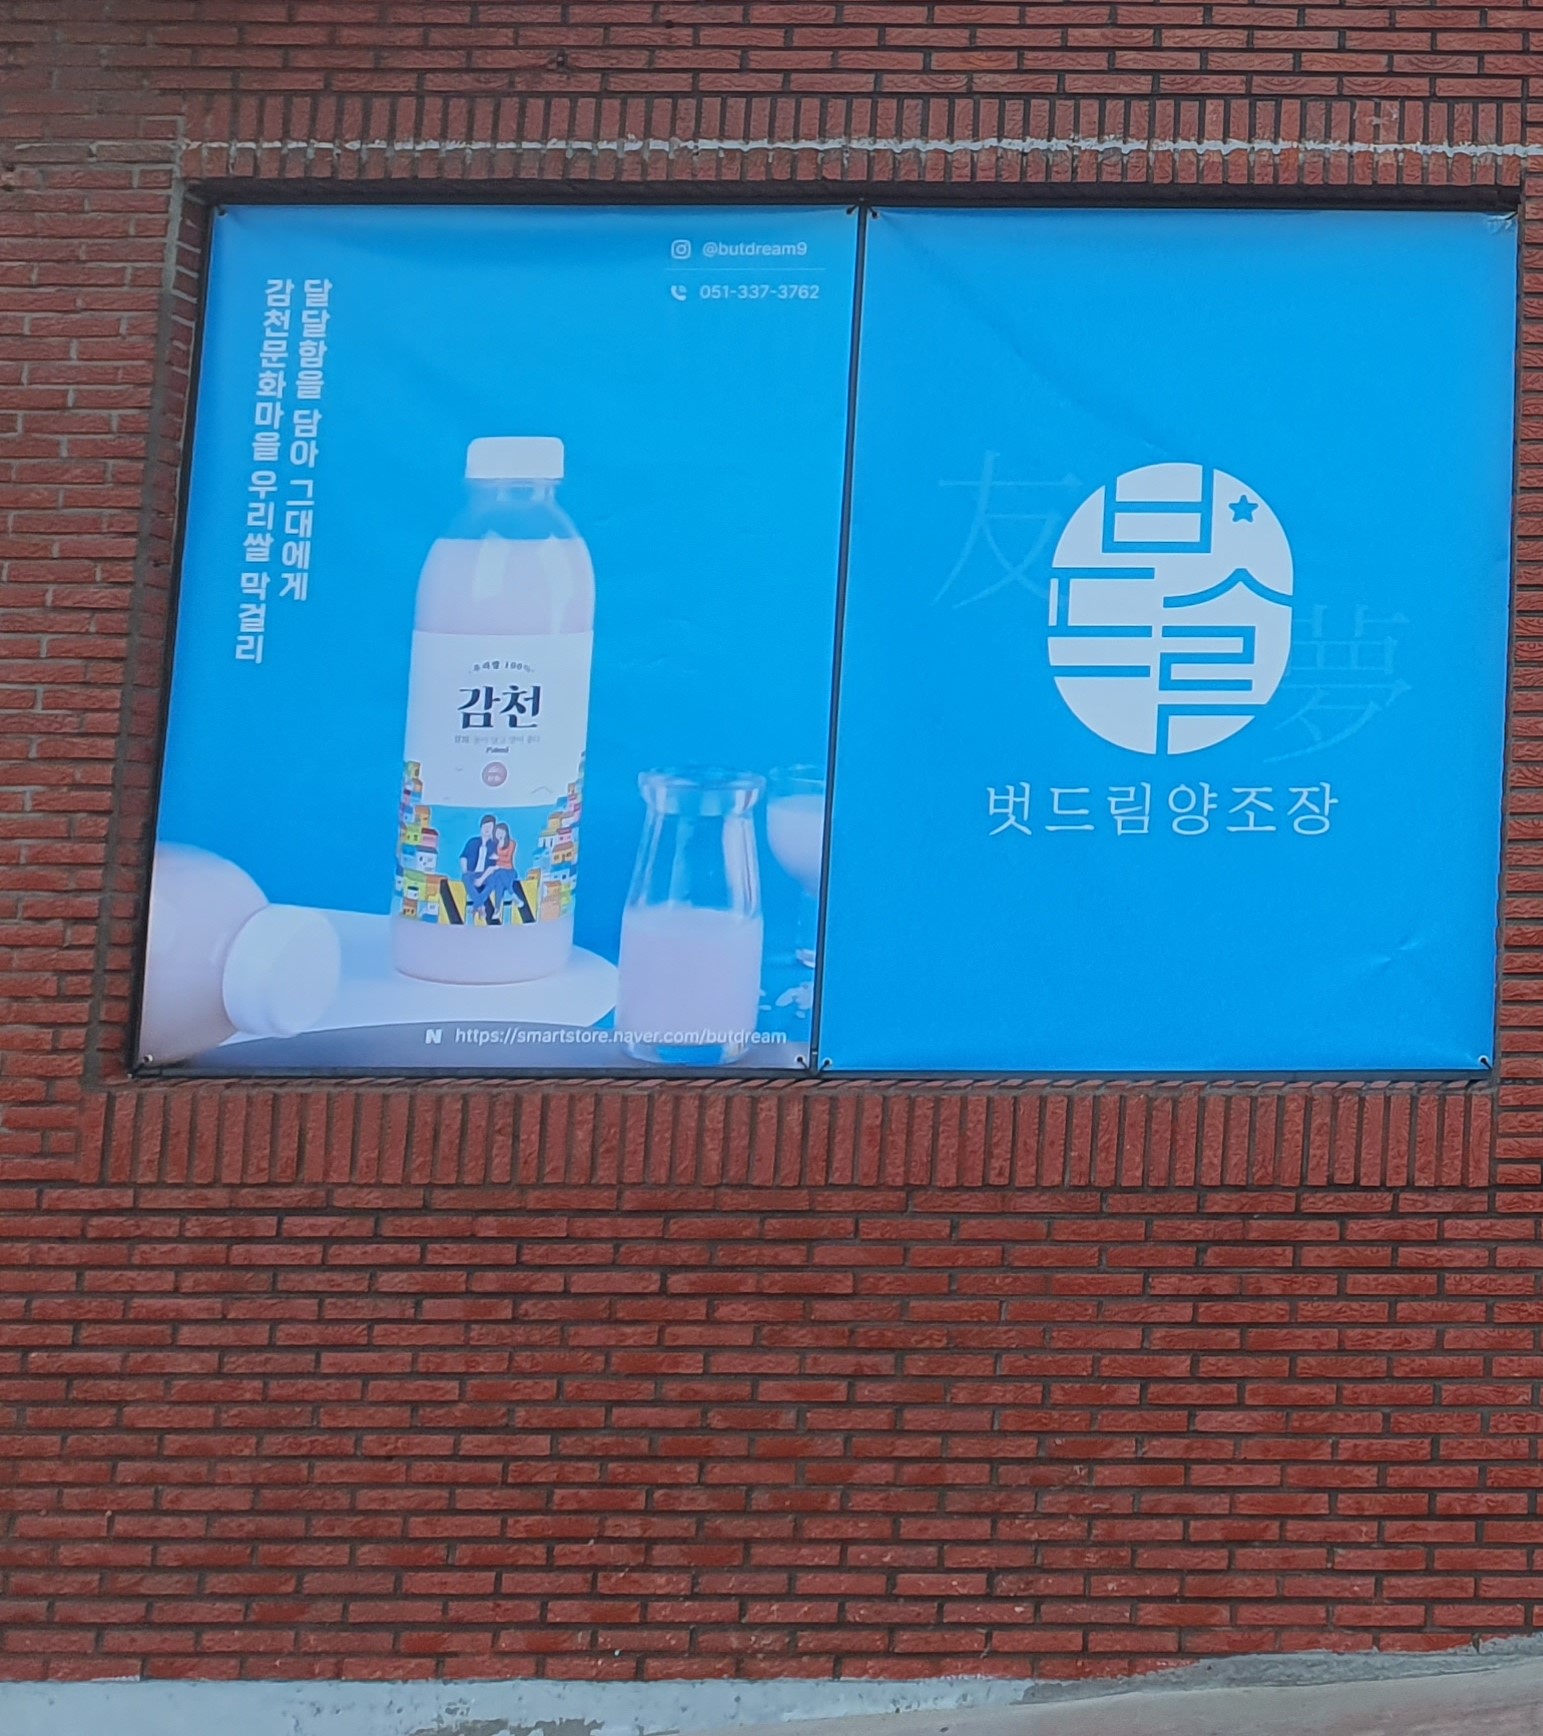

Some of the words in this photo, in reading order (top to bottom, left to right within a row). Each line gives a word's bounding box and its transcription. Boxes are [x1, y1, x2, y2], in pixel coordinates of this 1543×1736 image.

[702, 241, 808, 257] @butdream9
[700, 284, 820, 299] 051-337-3762
[296, 278, 333, 400] 달달함을
[251, 278, 295, 462] 감천문화마을
[290, 408, 322, 468] 담아
[243, 470, 275, 562] 우리쌀
[279, 479, 315, 601] 그대에게
[235, 571, 271, 665] 막걸리
[457, 685, 541, 729] 감천
[986, 781, 1339, 837] 벗드림양조장
[455, 1027, 787, 1047] https://smartstore.naver.com/butdream
